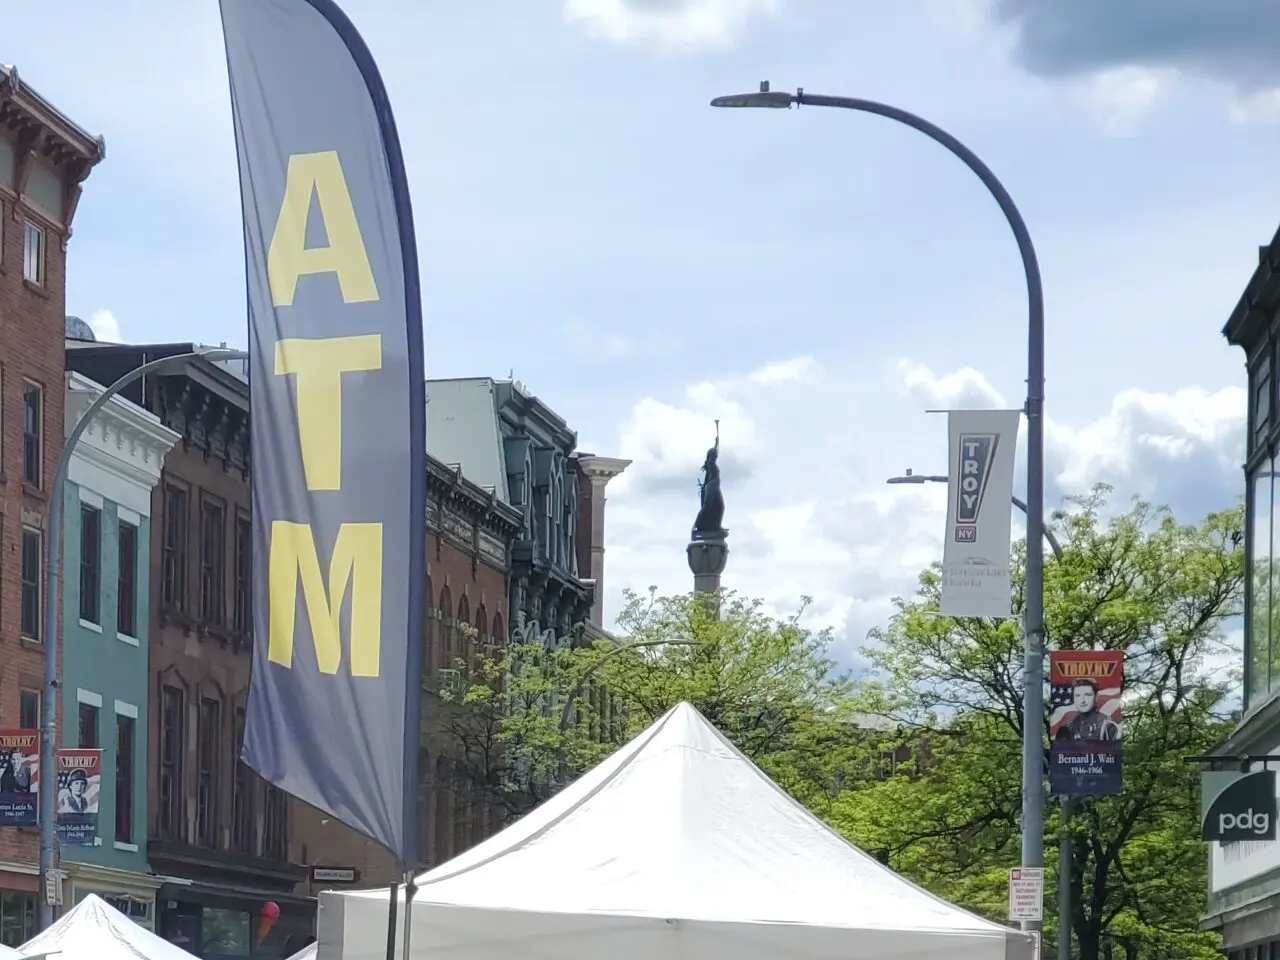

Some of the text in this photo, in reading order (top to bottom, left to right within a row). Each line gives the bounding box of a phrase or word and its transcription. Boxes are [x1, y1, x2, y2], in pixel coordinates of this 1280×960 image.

[267, 150, 382, 678] ATM
[963, 442, 980, 508] TROY
[959, 530, 973, 540] NY
[1058, 754, 1088, 763] Bernard
[1071, 766, 1103, 774] 1946-1966
[1219, 808, 1269, 834] pdg
